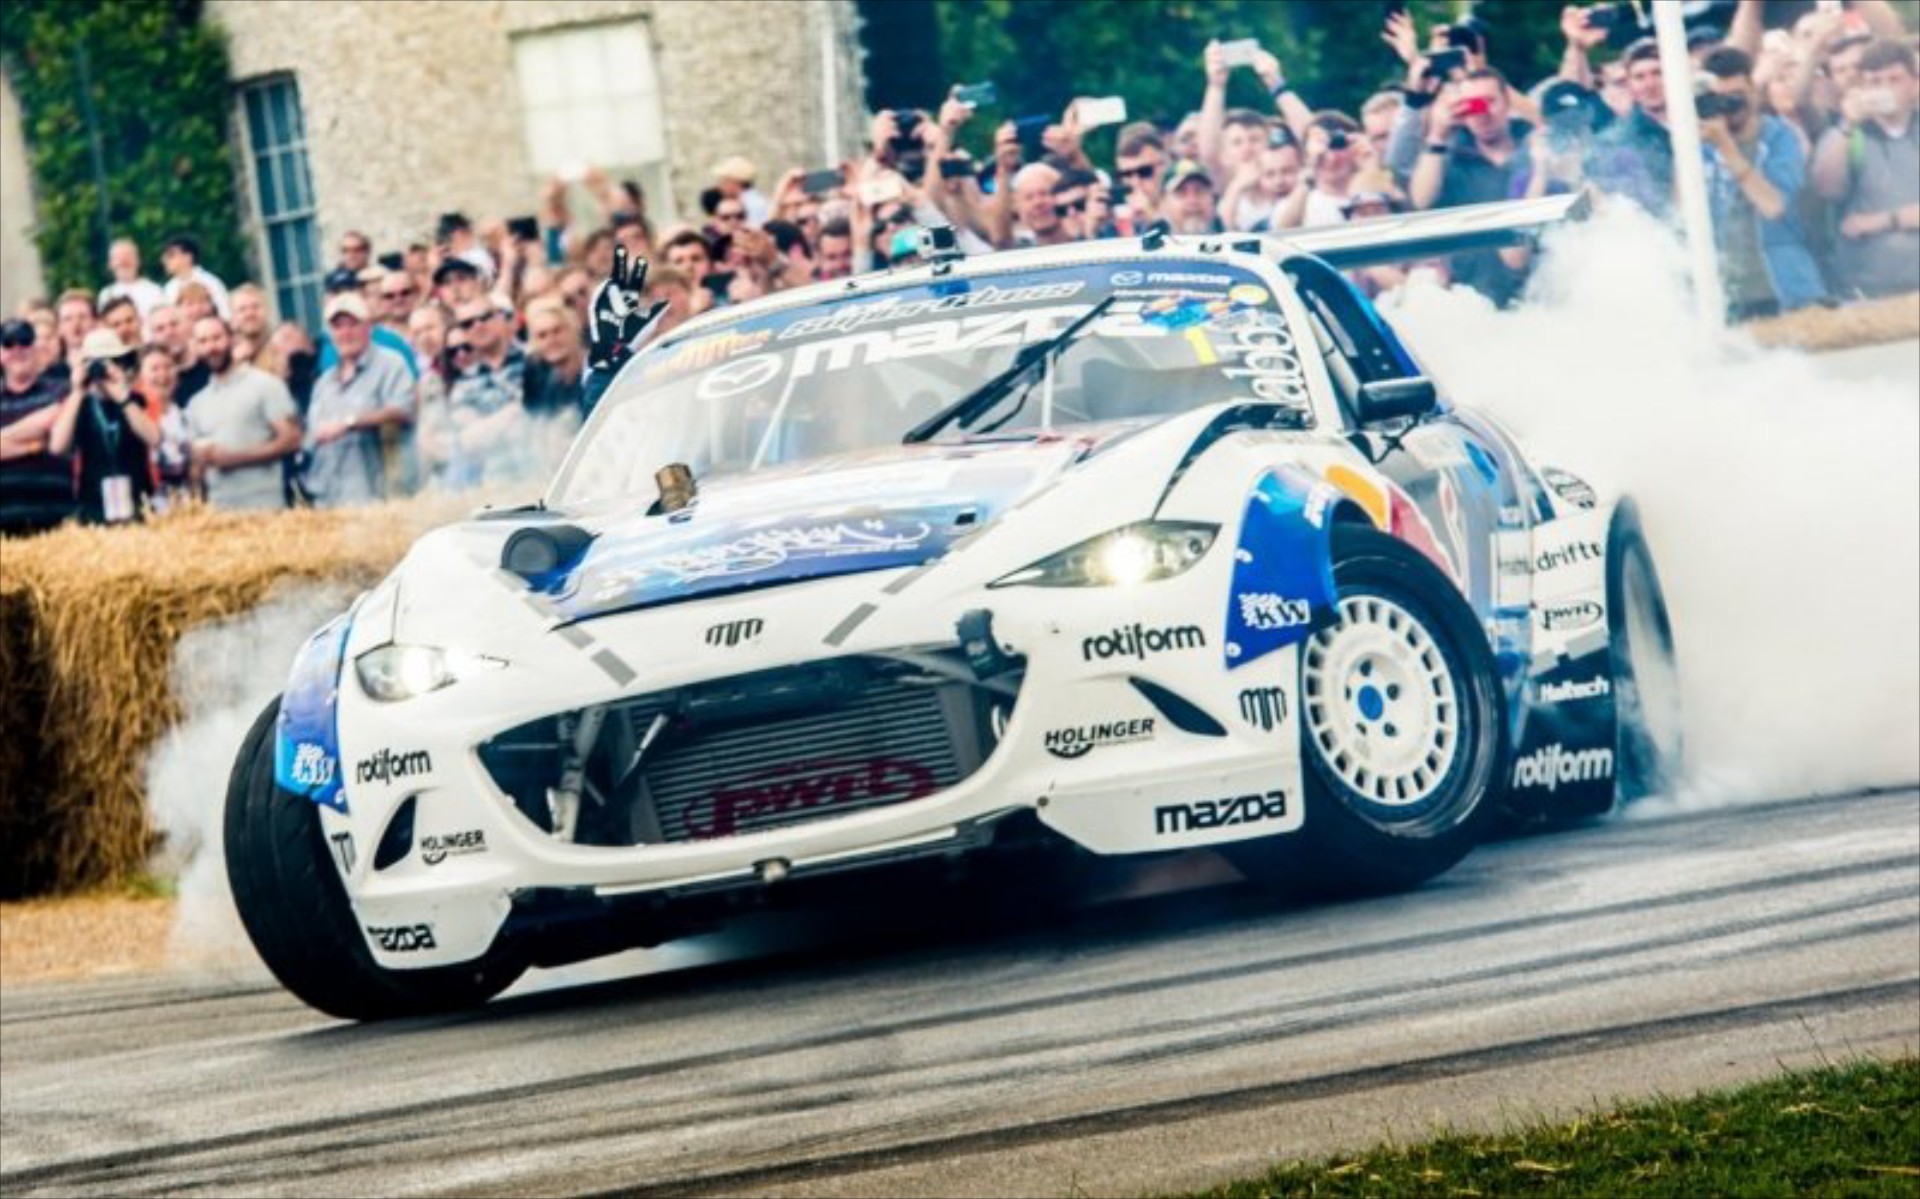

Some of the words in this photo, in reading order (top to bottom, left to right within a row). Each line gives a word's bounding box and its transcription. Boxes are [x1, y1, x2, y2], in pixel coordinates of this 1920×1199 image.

[1082, 622, 1206, 662] rotiform
[1044, 718, 1156, 749] HOLINGER
[356, 748, 432, 785] rotiform
[1511, 743, 1614, 792] rotiform
[1155, 790, 1288, 835] mazda
[420, 829, 485, 852] HOLINGER
